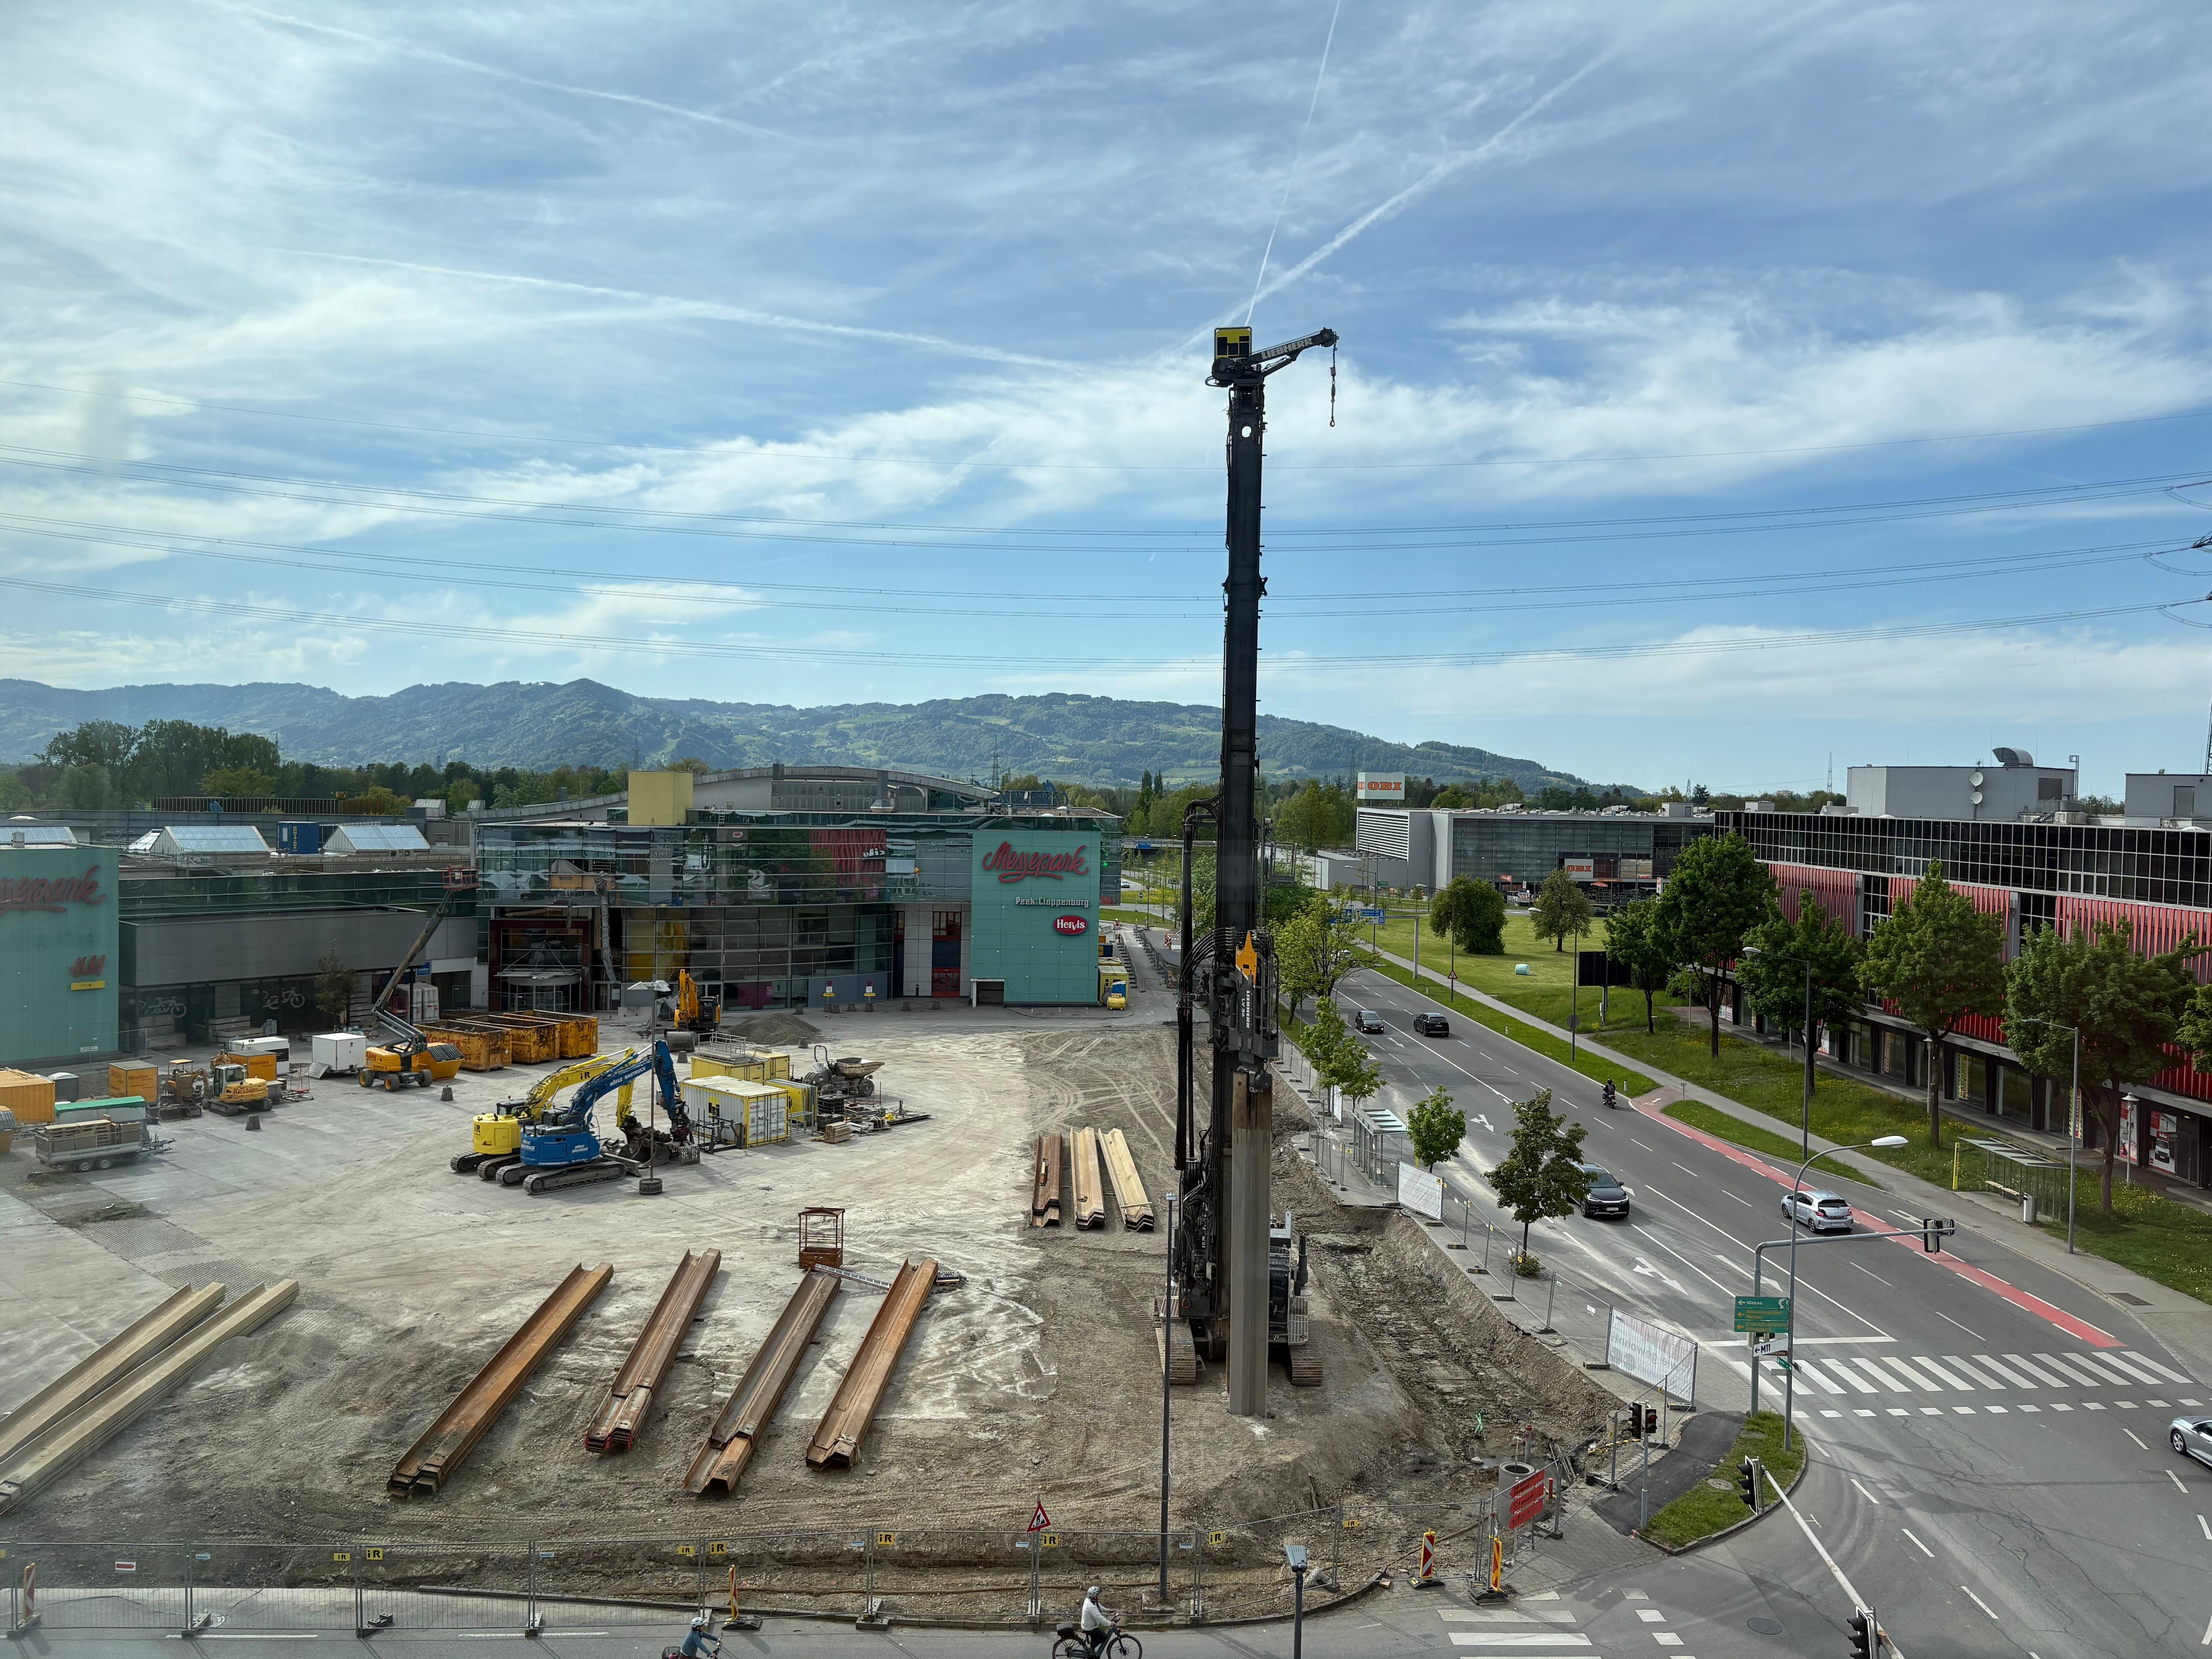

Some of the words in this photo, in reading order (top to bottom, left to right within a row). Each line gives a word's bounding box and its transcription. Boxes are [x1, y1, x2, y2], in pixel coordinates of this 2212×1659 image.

[1261, 337, 1313, 359] LIEBHERR
[1367, 781, 1402, 791] OBI
[983, 841, 1089, 883] Messepark
[1015, 896, 1035, 905] Peek
[1039, 896, 1090, 908] Cloppenburg
[1057, 919, 1085, 930] Hervis
[1242, 998, 1245, 1006] LV
[1241, 1007, 1245, 1018] 36
[580, 1071, 591, 1080] iR
[610, 1078, 623, 1087] HÖFLE
[624, 1066, 646, 1079] BAUTRUCK
[233, 1086, 258, 1094] Kessler
[474, 1124, 480, 1133] iR
[1761, 1343, 1770, 1353] M11
[879, 1534, 892, 1544] iR
[1043, 1535, 1057, 1545] iR
[1210, 1533, 1221, 1544] iR
[711, 1544, 725, 1553] iR
